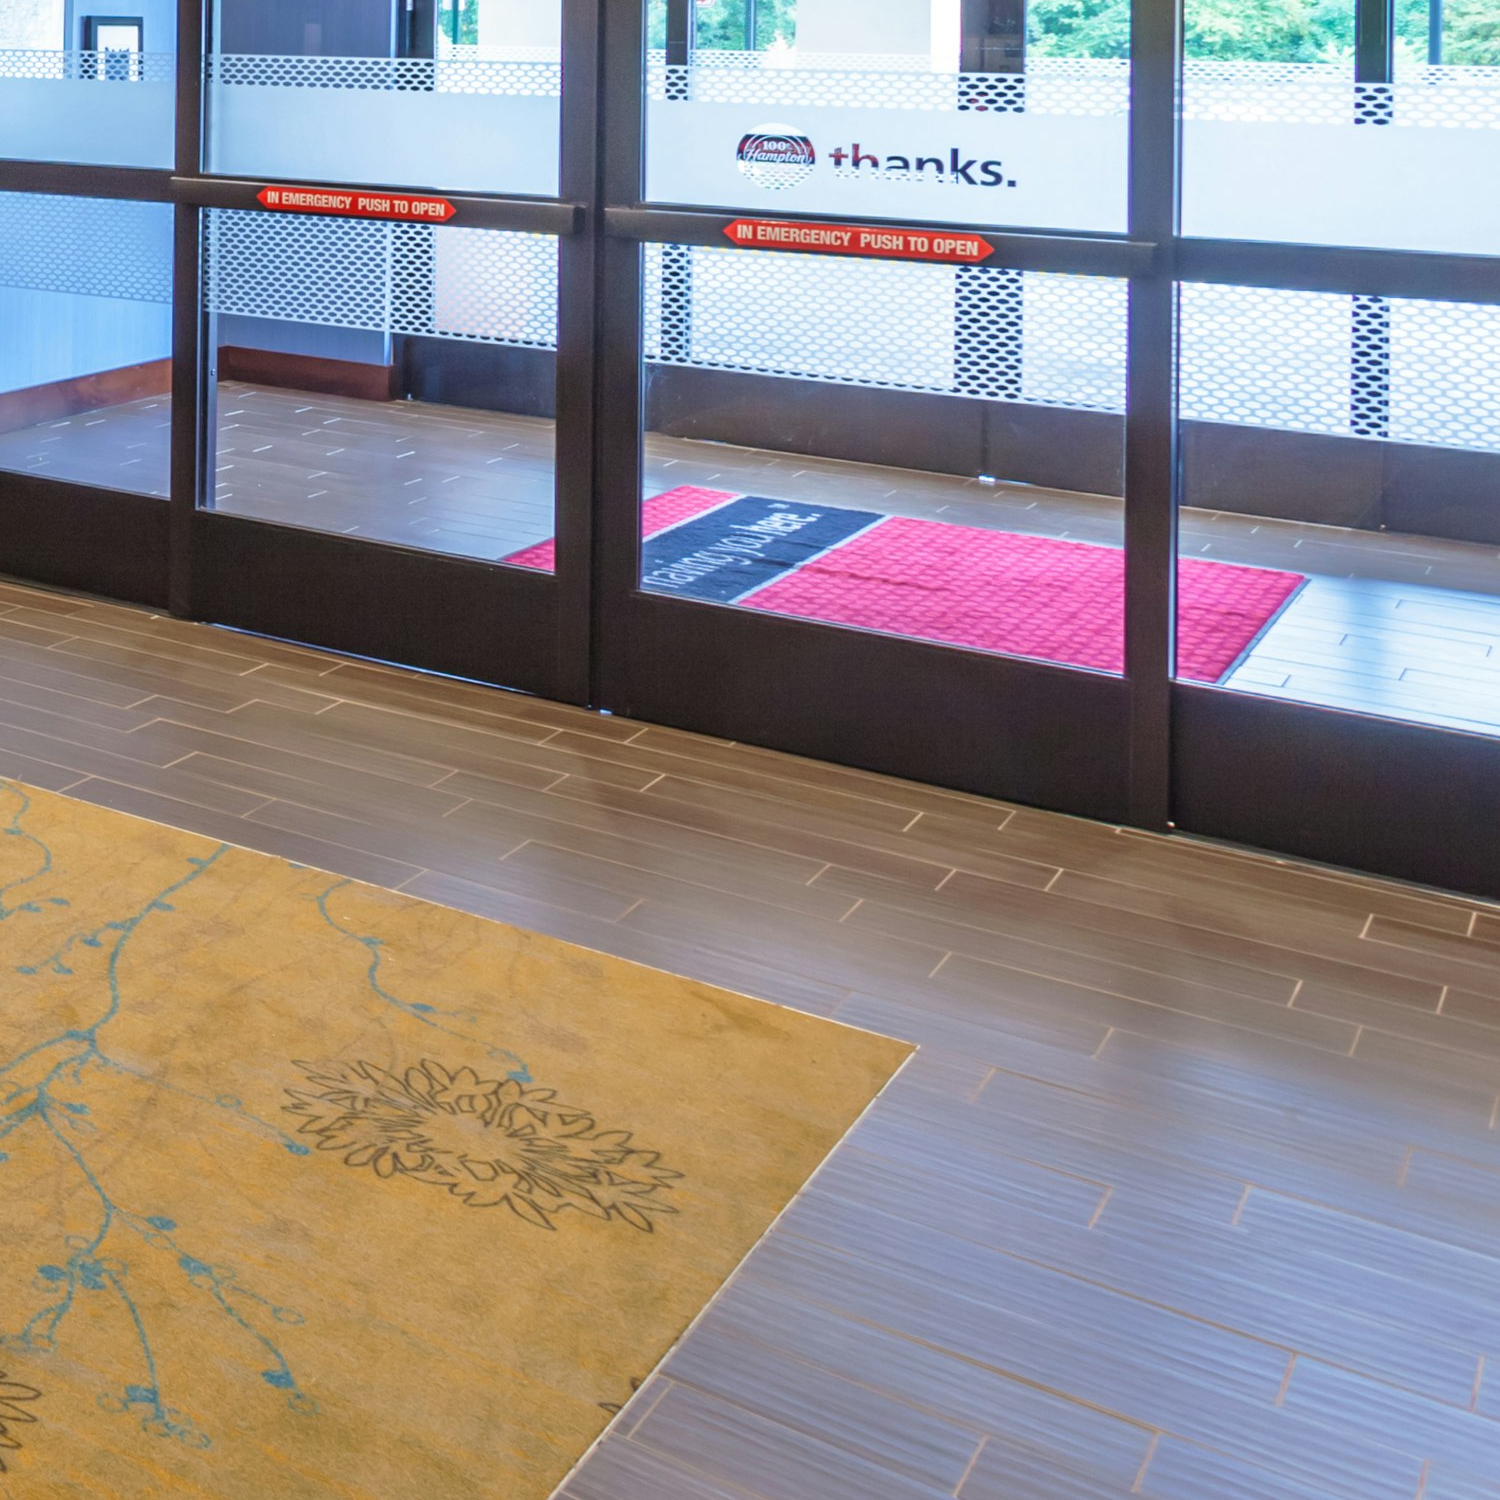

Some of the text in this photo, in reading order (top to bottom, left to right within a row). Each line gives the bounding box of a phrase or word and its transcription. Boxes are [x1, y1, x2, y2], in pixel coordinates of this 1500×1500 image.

[740, 148, 812, 165] Hampton
[828, 143, 1017, 188] thanks.
[267, 190, 445, 217] IN EMERGENCY PUSH TO OPEN
[737, 223, 979, 257] IN EMERGENCY PUSH TO OPEN
[707, 531, 775, 557] you
